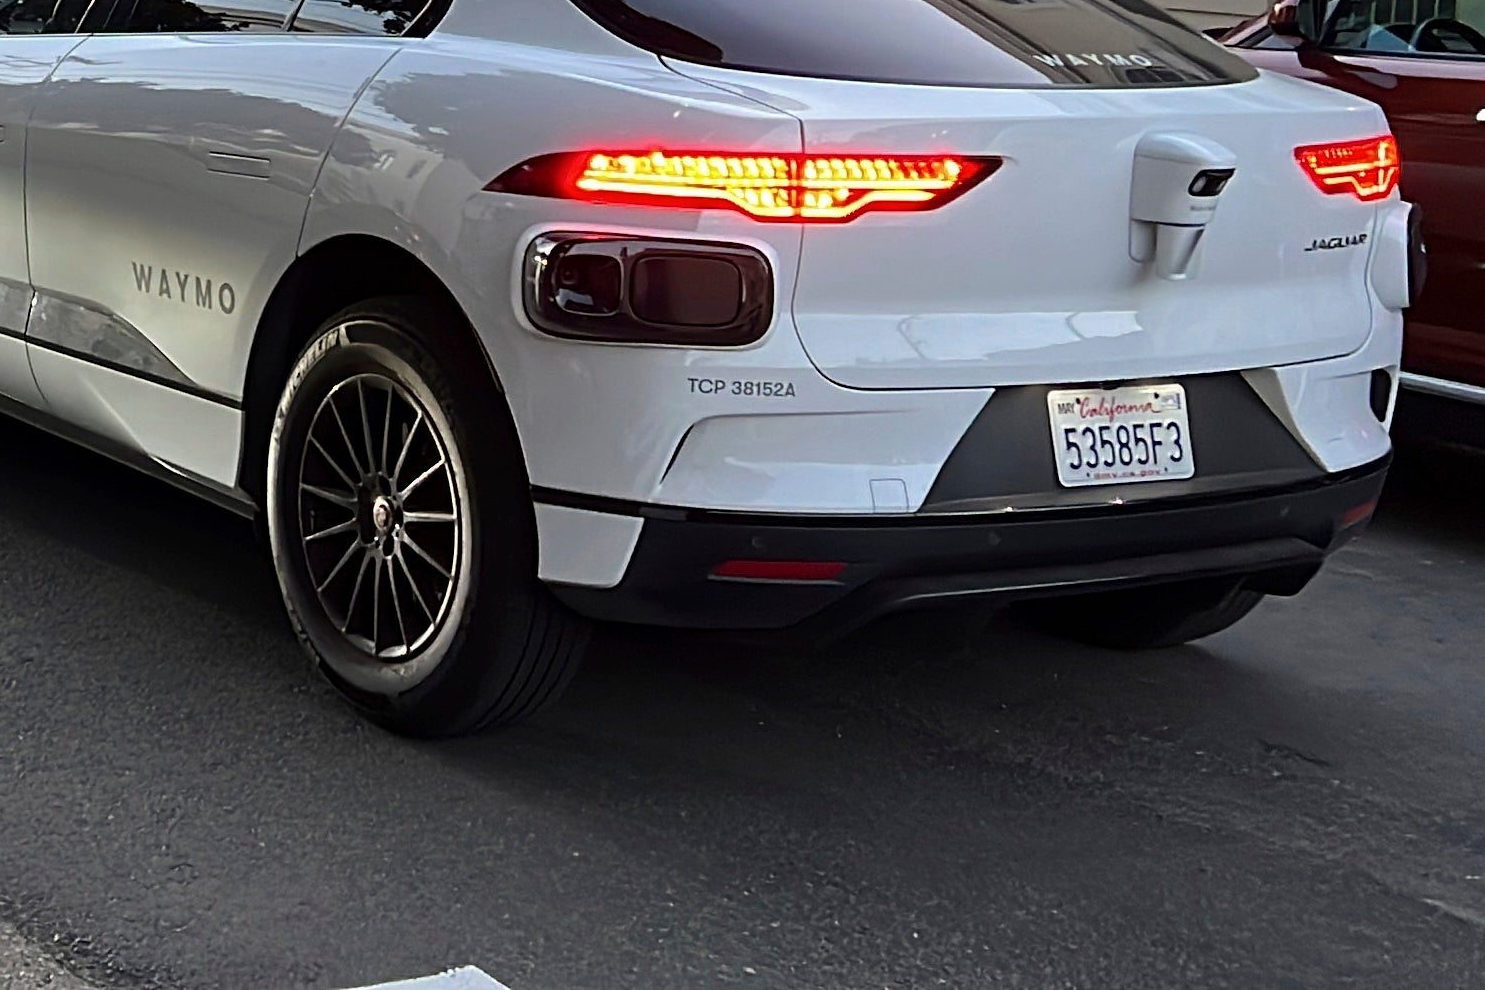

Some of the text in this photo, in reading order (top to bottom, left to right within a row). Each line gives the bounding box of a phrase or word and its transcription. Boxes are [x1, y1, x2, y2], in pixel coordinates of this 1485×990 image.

[1032, 53, 1152, 67] WAYMO
[1304, 233, 1368, 251] JAGUAR
[131, 261, 235, 314] WAYMO
[687, 377, 796, 397] TCP 38152A
[1079, 396, 1163, 423] California
[1064, 421, 1183, 470] 53585F3
